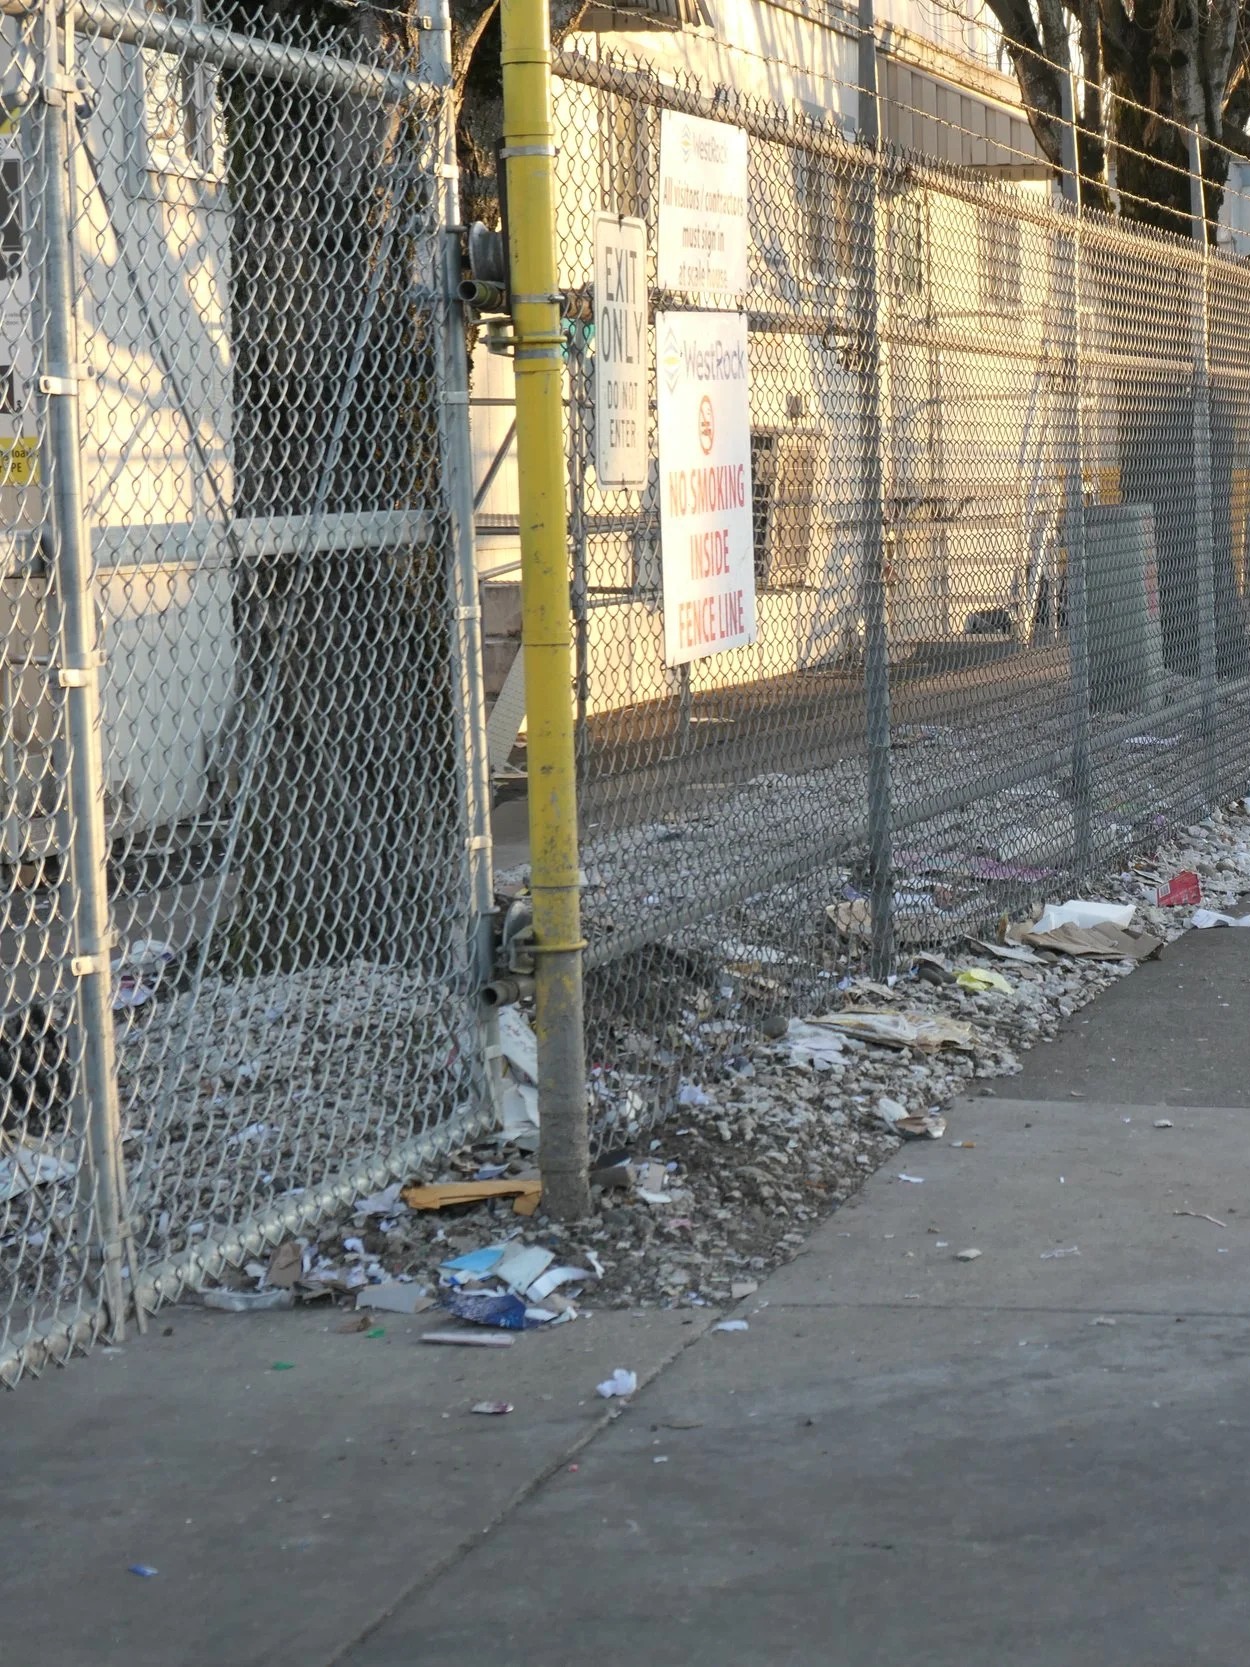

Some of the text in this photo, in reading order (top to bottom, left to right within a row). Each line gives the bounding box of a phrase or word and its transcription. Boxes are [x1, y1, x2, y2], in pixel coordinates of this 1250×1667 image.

[663, 176, 673, 206] All
[674, 179, 700, 211] visitors
[705, 189, 744, 217] contractors
[682, 221, 725, 258] must sign in
[606, 246, 637, 305] EXIT
[687, 258, 706, 289] scale
[602, 306, 643, 365] ONLY
[683, 340, 745, 381] WestRock
[607, 379, 638, 411] DO NOT
[610, 418, 636, 449] ENTER
[669, 463, 745, 518] NO SMOKING
[690, 528, 730, 581] INSIDE
[679, 589, 745, 649] FENCE LINE
